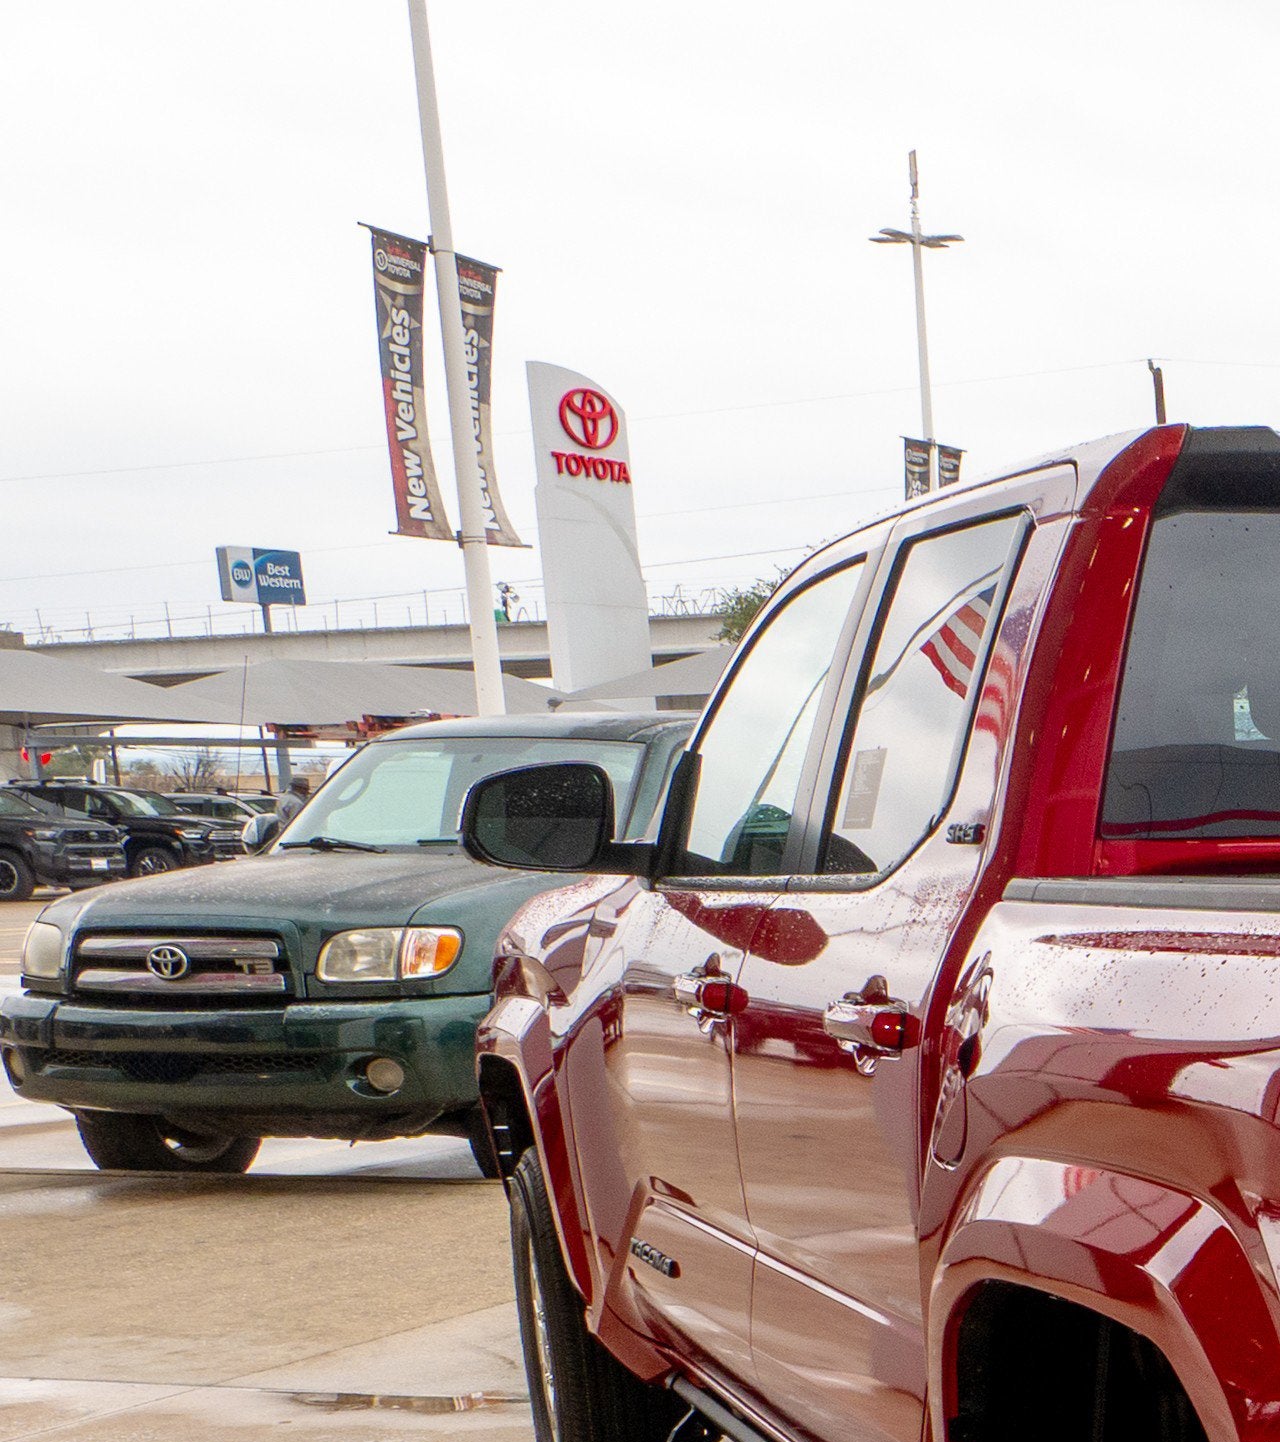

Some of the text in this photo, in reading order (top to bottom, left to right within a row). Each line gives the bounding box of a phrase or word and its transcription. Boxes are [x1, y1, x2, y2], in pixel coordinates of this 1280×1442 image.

[389, 307, 433, 522] New Vehicles
[551, 451, 631, 484] TOYOTA
[258, 574, 301, 589] Western
[266, 563, 290, 576] Best
